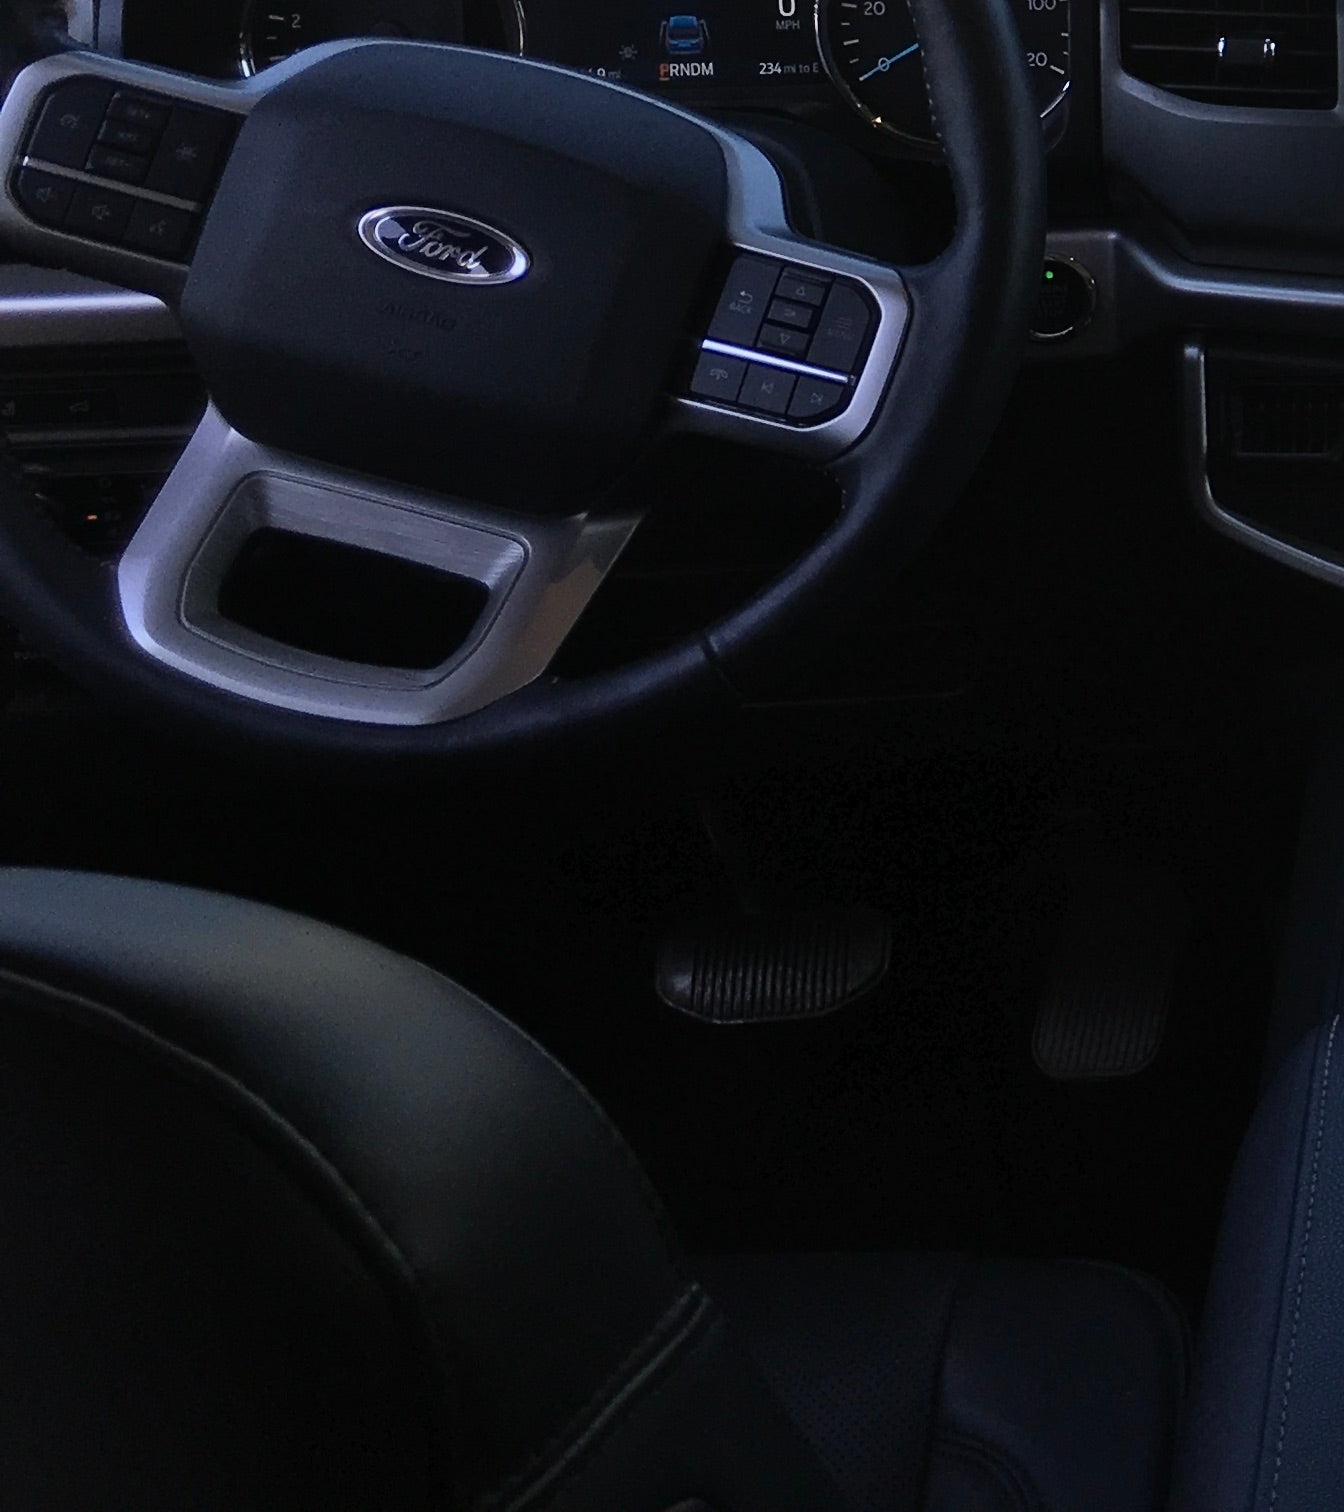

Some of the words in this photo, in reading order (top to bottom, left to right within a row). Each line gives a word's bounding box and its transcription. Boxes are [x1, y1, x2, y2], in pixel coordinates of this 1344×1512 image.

[863, 0, 887, 16] 20
[291, 13, 302, 28] 2
[776, 19, 801, 31] MPH
[1026, 52, 1048, 67] 20
[759, 62, 782, 76] 234
[784, 63, 797, 75] mi
[799, 63, 811, 74] to
[812, 62, 820, 74] E
[397, 220, 489, 270] Ford
